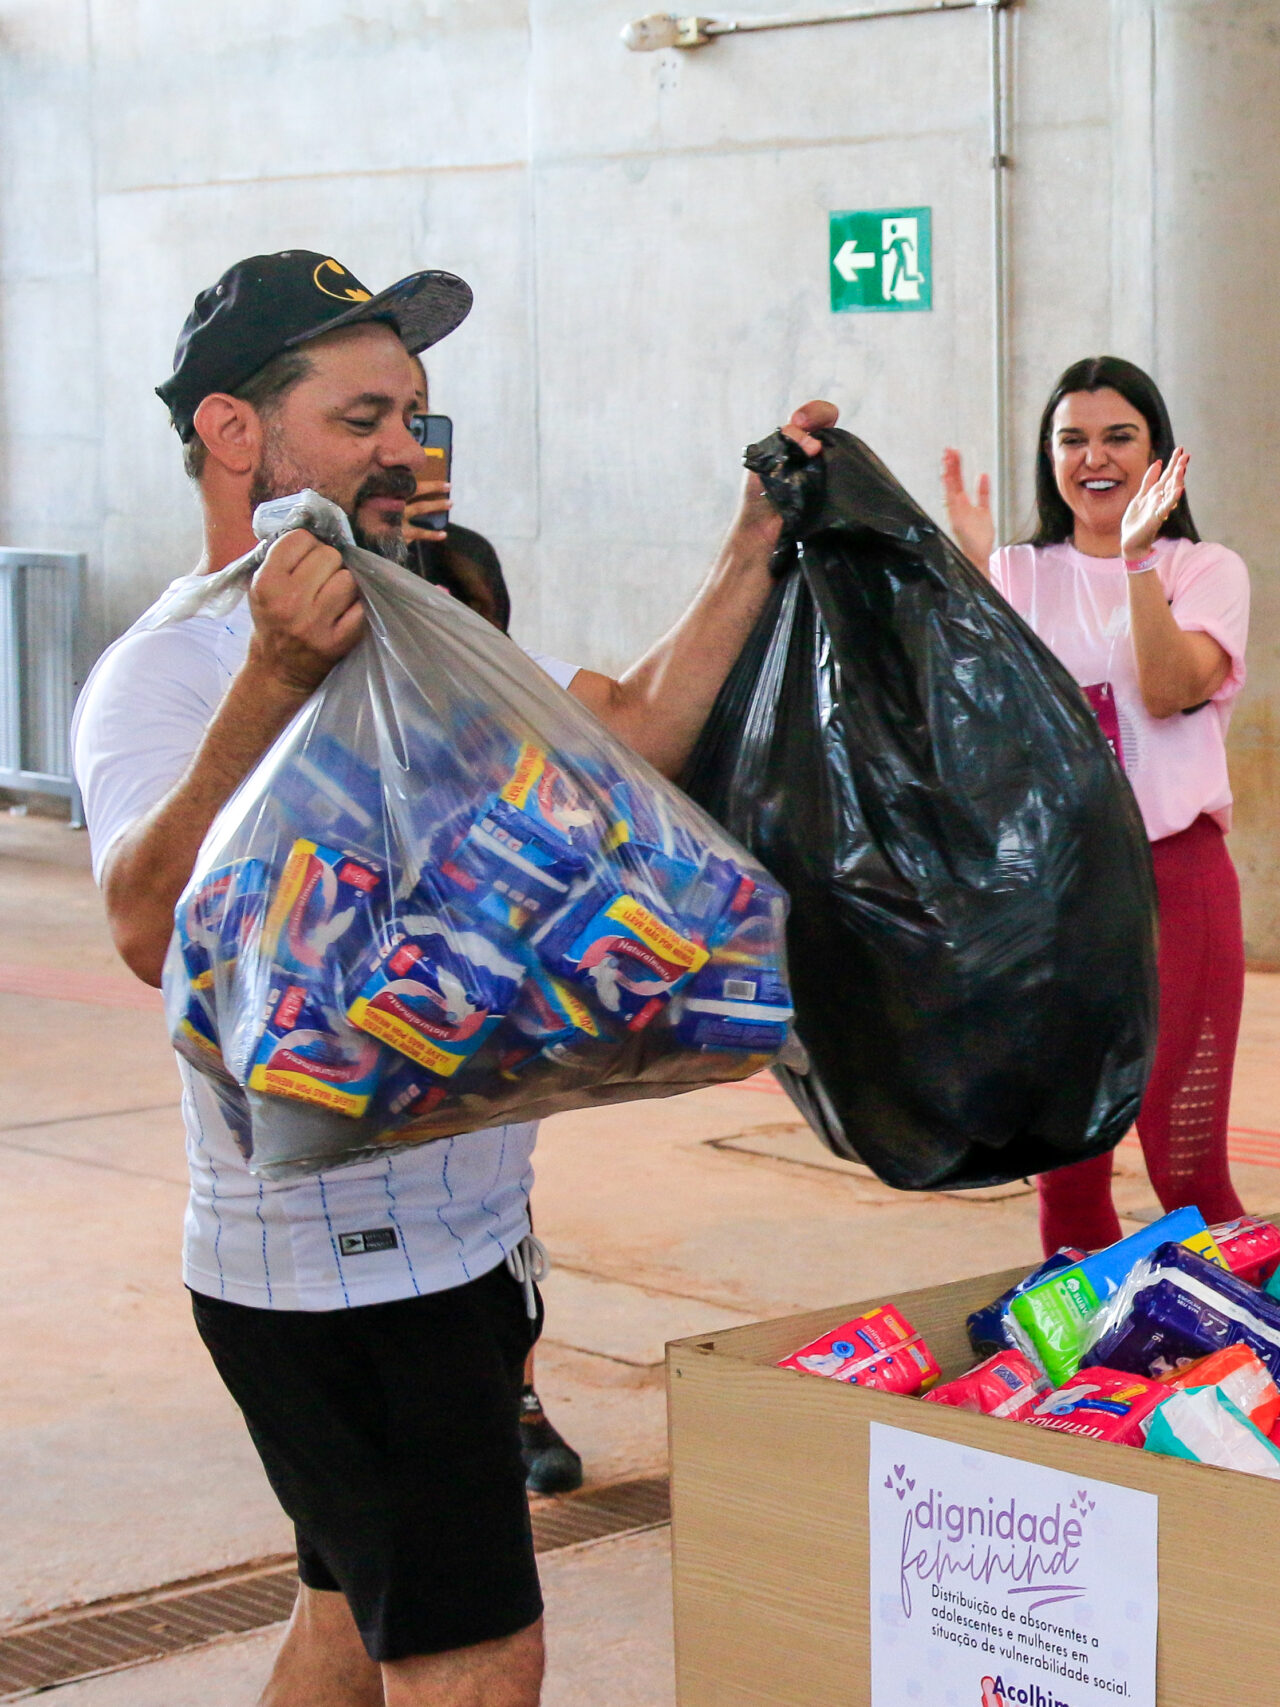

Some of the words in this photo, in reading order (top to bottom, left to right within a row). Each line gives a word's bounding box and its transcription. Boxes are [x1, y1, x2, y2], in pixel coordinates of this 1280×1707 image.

[386, 994, 450, 1039] Naturalmente
[914, 1488, 1083, 1548] dignidade
[900, 1509, 1080, 1619] feminina
[931, 1583, 998, 1617] Distribuição
[1001, 1605, 1016, 1622] de
[1019, 1611, 1088, 1645] absorventes
[1091, 1636, 1099, 1648] a
[931, 1605, 1004, 1638] adolescentes
[1006, 1629, 1013, 1640] e
[1017, 1633, 1069, 1658] mulheres
[1071, 1651, 1089, 1665] em
[931, 1622, 978, 1649] situação
[981, 1637, 996, 1654] de
[999, 1645, 1090, 1685] vulnerabilidade
[1093, 1676, 1131, 1698] social.
